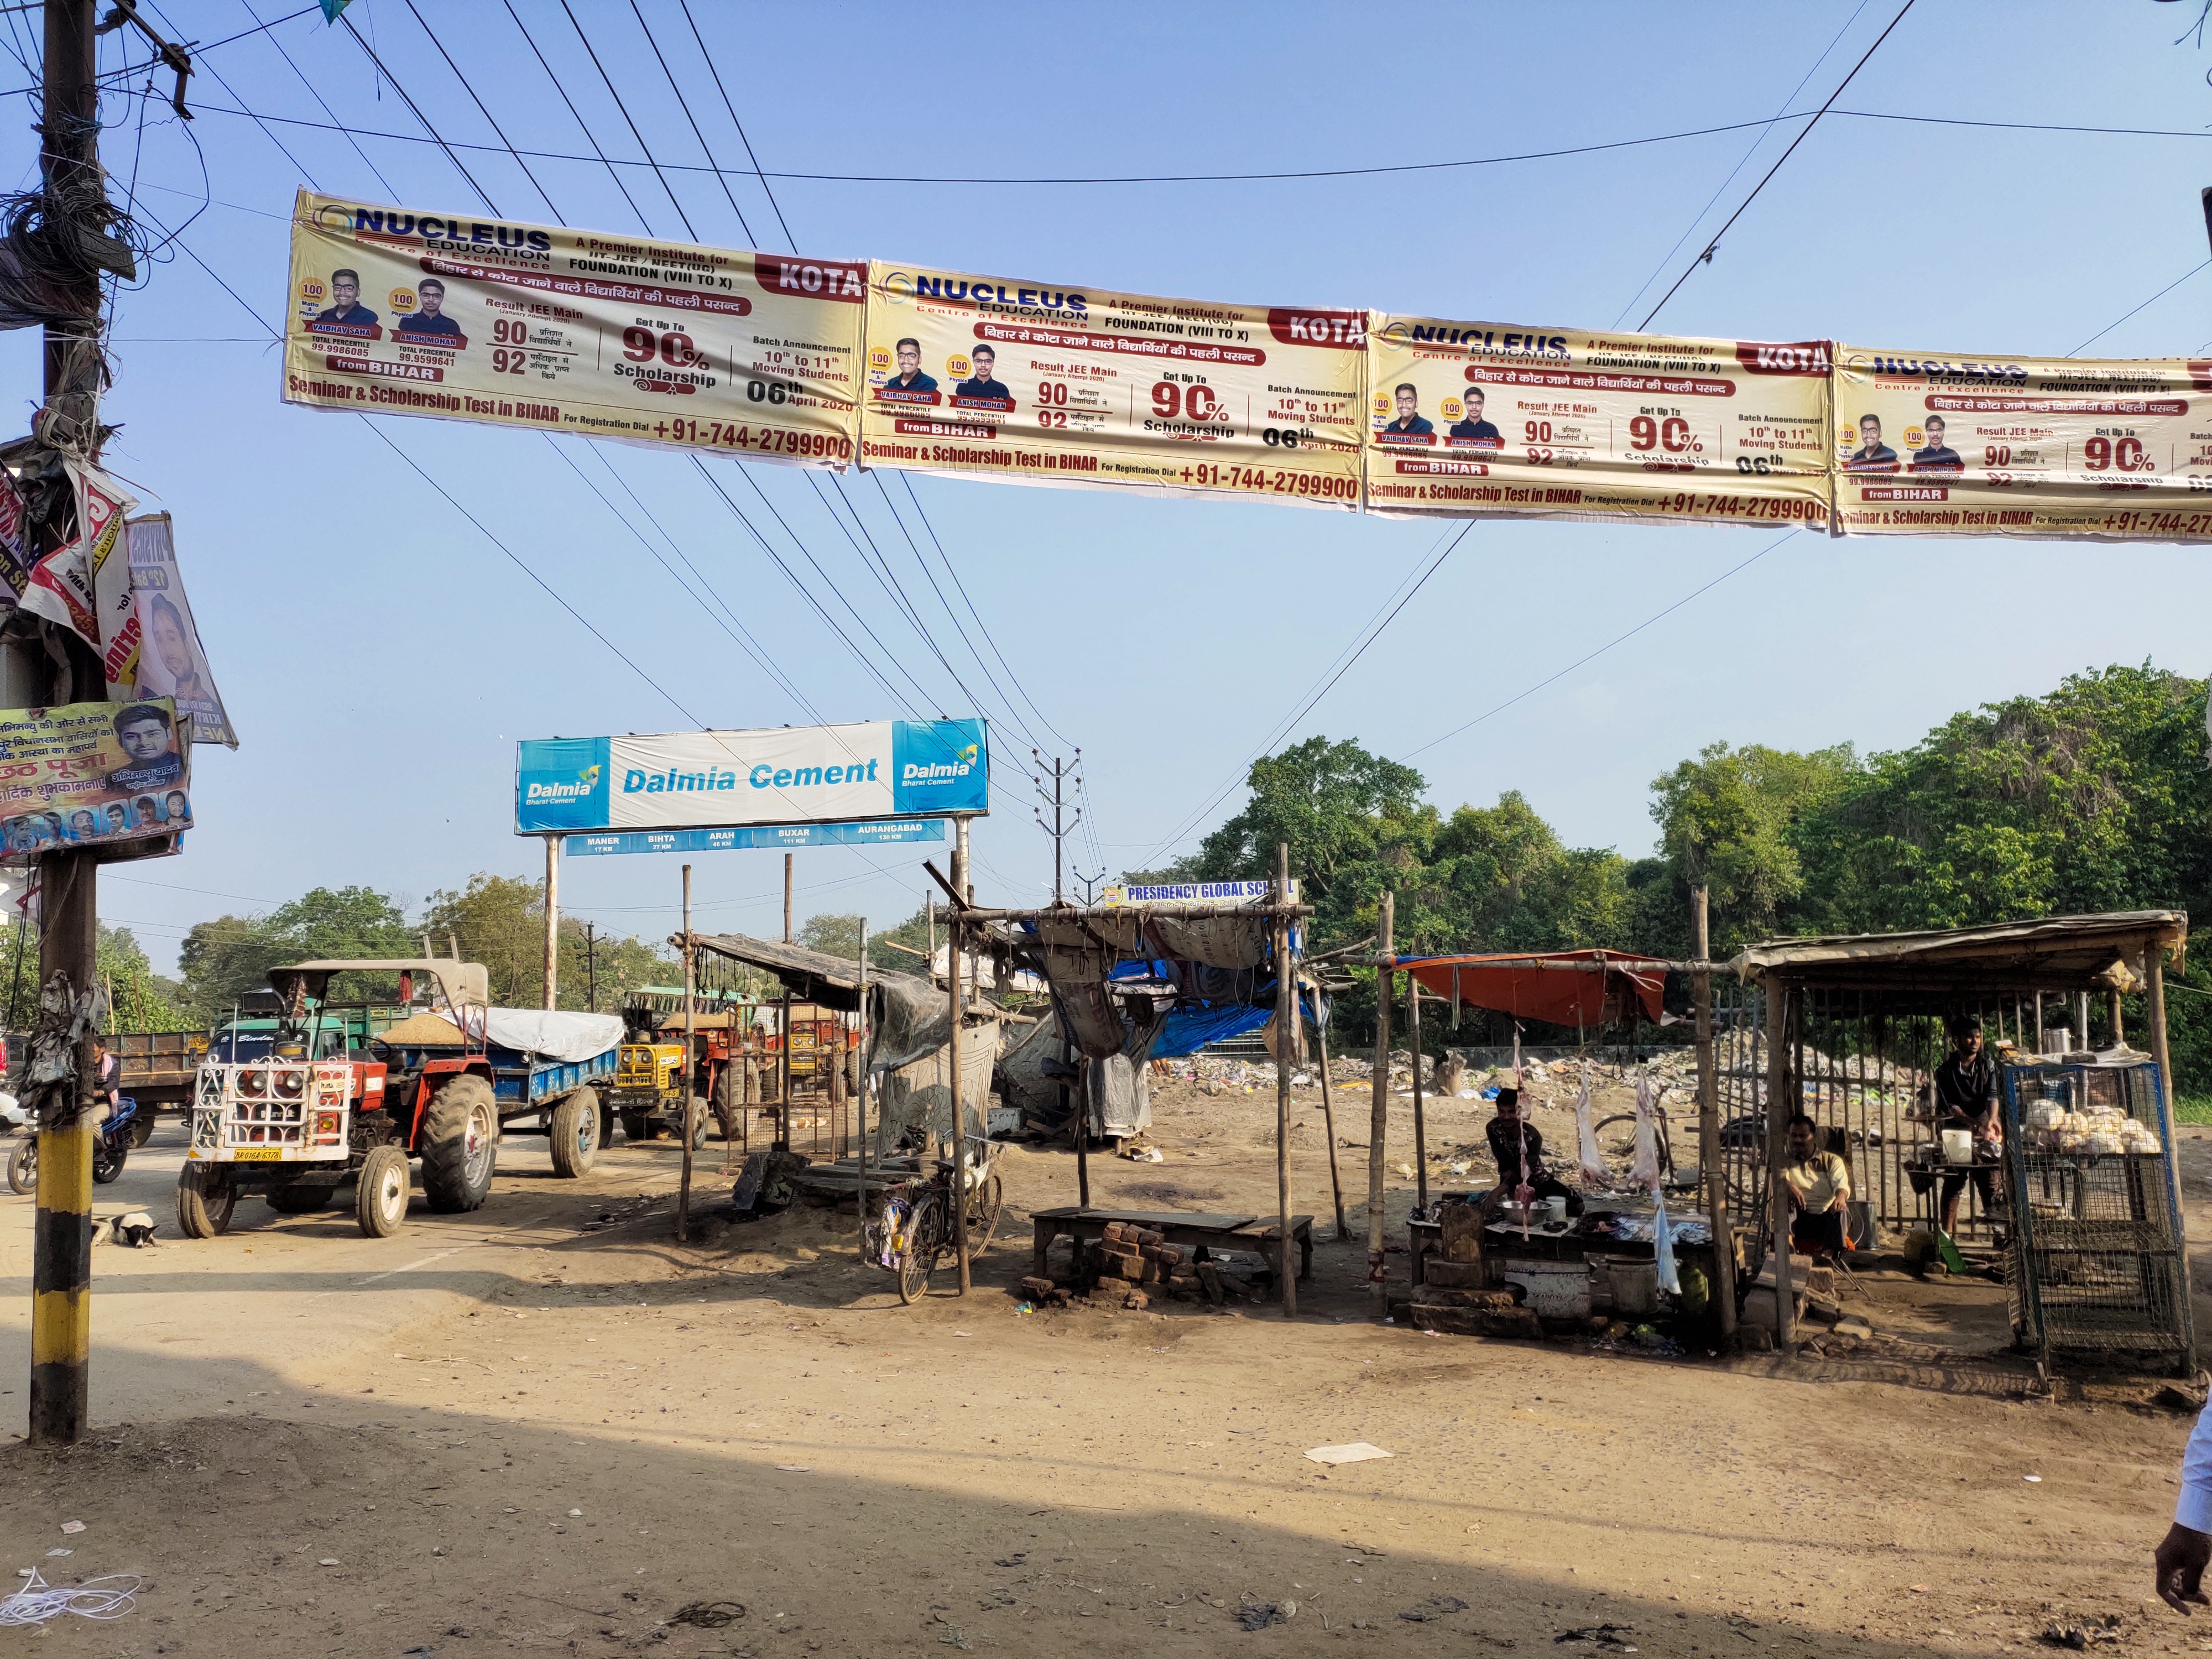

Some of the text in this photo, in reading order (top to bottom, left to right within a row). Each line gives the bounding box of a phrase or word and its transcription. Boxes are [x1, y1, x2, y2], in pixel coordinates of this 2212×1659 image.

[355, 208, 551, 251] NUCLEUS
[426, 250, 550, 270] of Excellence
[427, 239, 550, 262] EDUCATION
[590, 239, 729, 265] Premier Institute for
[570, 258, 732, 290] FOUNDATION (VIII TO X)
[780, 263, 862, 297] KOTA
[304, 284, 322, 295] 100
[432, 260, 740, 313] बिहार से कोटा जाने वाले विद्यार्थियों की पहली पसन्द
[916, 275, 1088, 311] NUCLEUS
[393, 294, 413, 305] 100
[486, 298, 583, 319] Result JEE Main
[979, 302, 1088, 321] EDUCATION
[313, 324, 371, 337] VAIBHAV SAHA
[493, 319, 527, 345] 90
[635, 317, 685, 331] Get Up To
[1105, 317, 1183, 335] FOUNDATION
[1290, 316, 1366, 345] KOTA
[312, 336, 370, 348] TOTAL PERCENTILE
[400, 333, 456, 346] ANISH MOHAN
[623, 325, 710, 371] 90%
[753, 336, 851, 354] Batch Announcement
[1117, 339, 1169, 354] विद्यार्थियों
[1412, 325, 1568, 354] NUCLEUS
[312, 343, 369, 357] 99.9986085
[399, 353, 455, 367] 99.9599641
[419, 348, 456, 358] PERCENTILE
[764, 349, 839, 369] 10th to 11th
[1471, 346, 1571, 360] EDUCATION
[1757, 347, 1830, 373] KOTA
[337, 359, 434, 379] from BIHAR
[493, 349, 526, 375] 92
[752, 362, 849, 382] Moving Students
[1587, 356, 1660, 369] FOUNDATION
[1874, 357, 2029, 379] NUCLEUS
[614, 363, 716, 389] Scholarship
[1929, 377, 2027, 387] EDUCATION
[787, 393, 853, 413] April 2020
[1151, 382, 1229, 422] 90%
[289, 375, 850, 460] Seminar Scholarship Test in BIHAR For Registration Dial +91-744-2799900
[932, 422, 989, 437] BIHAR
[1144, 420, 1235, 439] Scholarship
[1629, 416, 1703, 452] 90%
[2085, 436, 2155, 471] 90%
[932, 445, 1358, 499] Scholarship BIHAR +91-744-2799900
[1430, 484, 1827, 521] Scholarship BIHAR +91-744-2799900
[1893, 489, 1942, 499] BIHAR
[1892, 509, 1959, 526] Scholarship
[623, 758, 879, 794] Dalmia Cement
[904, 761, 969, 779] Dalmia
[528, 781, 591, 797] Dalmia
[858, 824, 922, 833] AURANGABAD
[587, 837, 619, 846] MANER
[648, 835, 675, 843] BIHTA
[1128, 880, 1293, 900] PRESIDENCY GLOBAL SCHL
